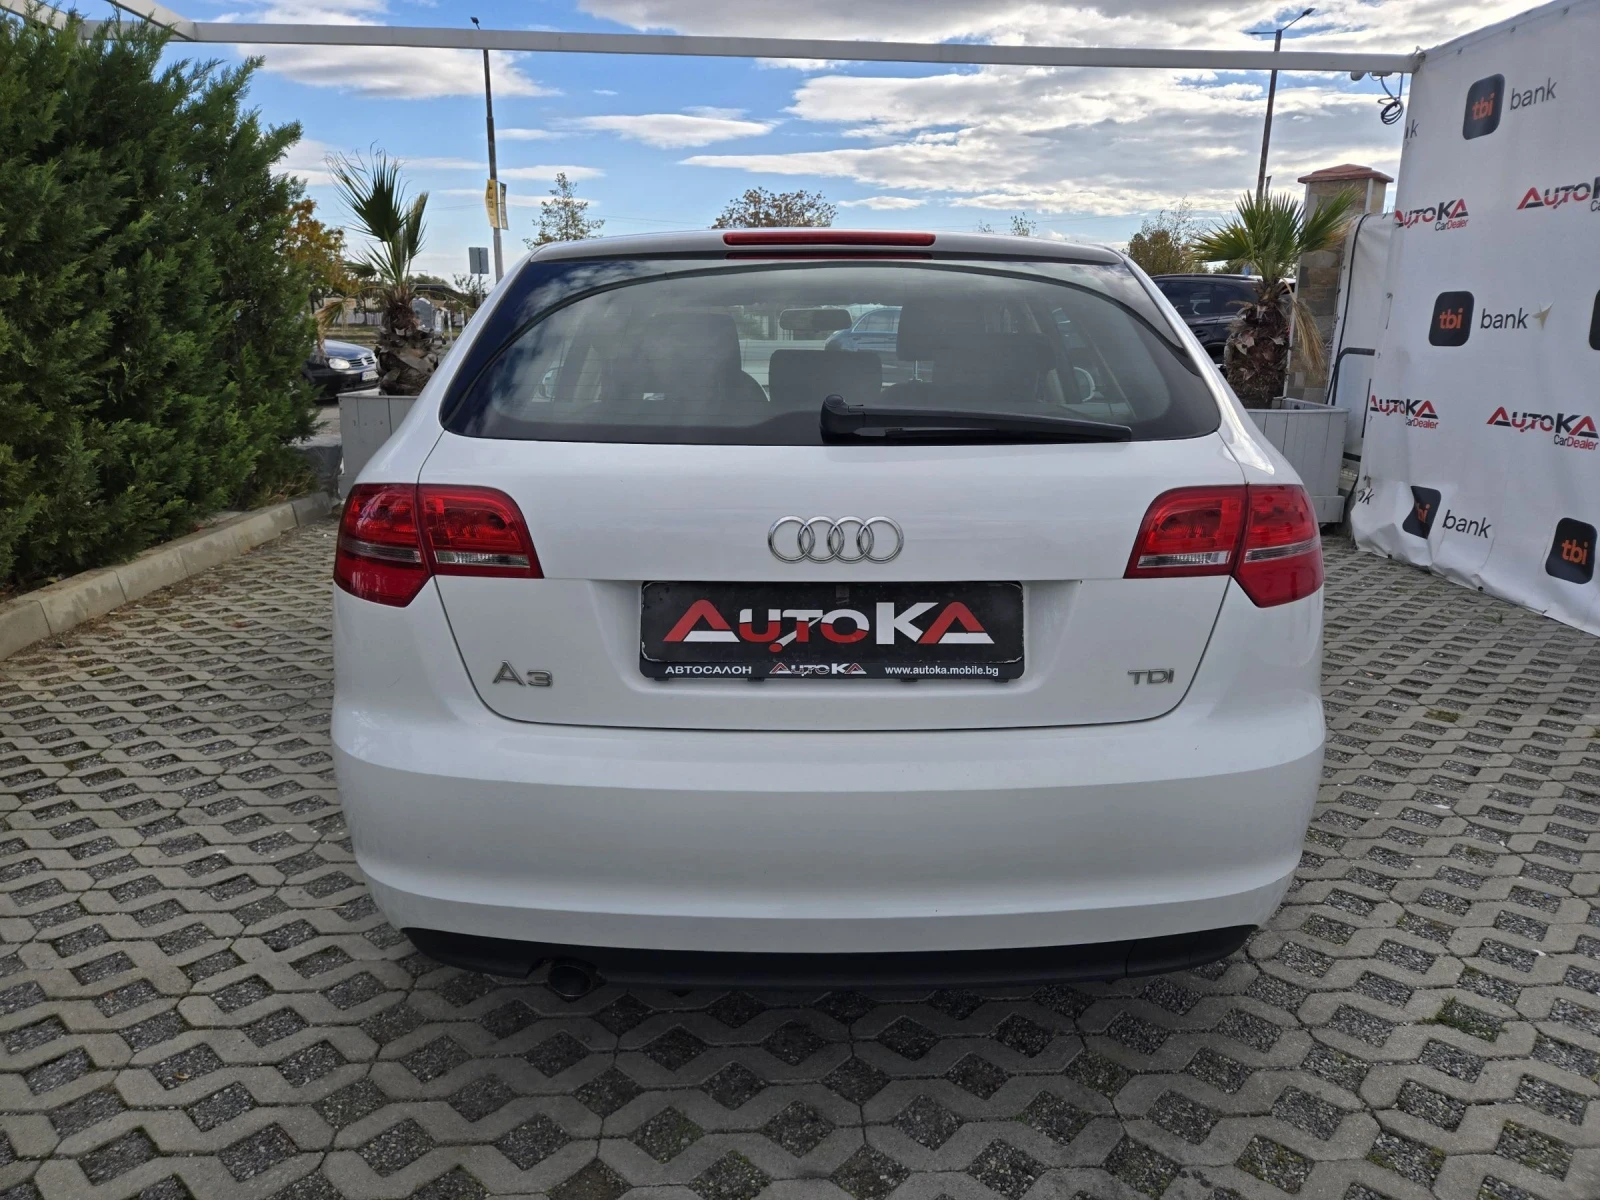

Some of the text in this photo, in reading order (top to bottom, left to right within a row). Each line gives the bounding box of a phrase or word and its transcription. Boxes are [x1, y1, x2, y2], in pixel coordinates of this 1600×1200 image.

[1472, 77, 1558, 121] tbi bank
[1439, 307, 1530, 330] tbi bank
[1486, 406, 1600, 439] AUTOKA
[1553, 433, 1599, 451] CarDealer
[1442, 509, 1493, 539] bank
[1561, 538, 1589, 565] tbi
[662, 599, 996, 653] AUTOKA
[492, 659, 553, 687] A3
[664, 665, 752, 675] АВТОСАЛОН
[768, 662, 868, 677] AUTOKA
[884, 665, 1000, 677] www.autoka.mobile.bg
[1127, 667, 1175, 685] TDI
